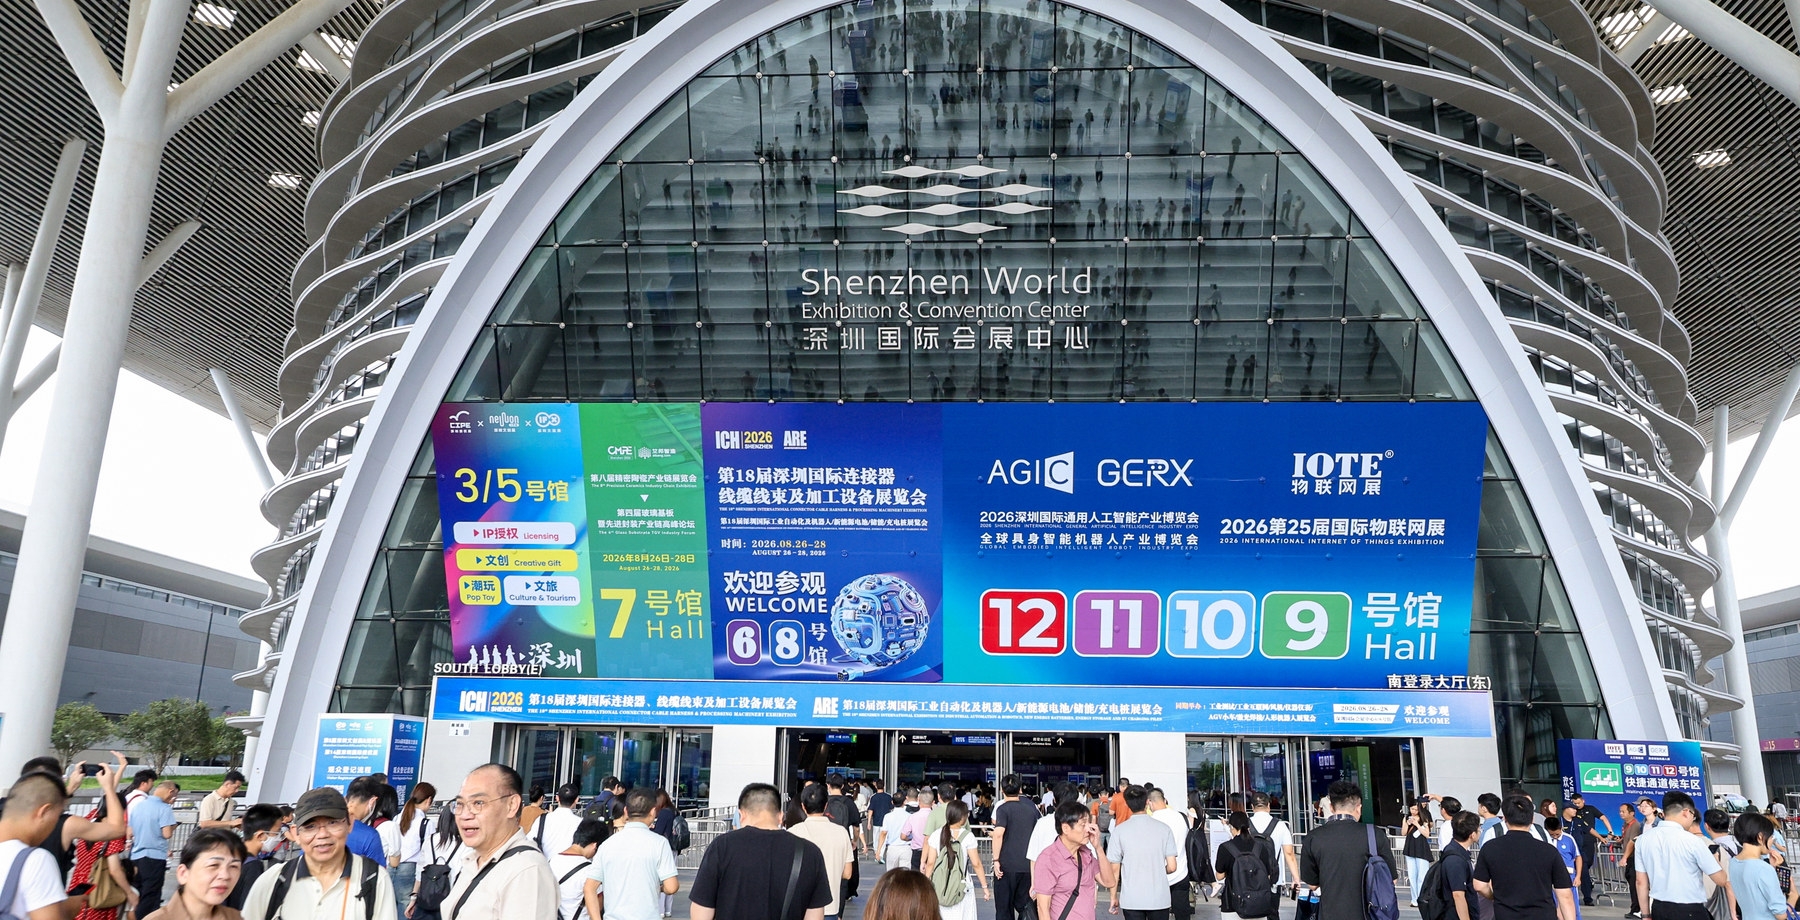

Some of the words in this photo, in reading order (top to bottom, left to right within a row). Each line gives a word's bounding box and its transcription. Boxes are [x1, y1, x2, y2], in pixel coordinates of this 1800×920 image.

[800, 266, 969, 296] Shenzhen
[983, 266, 1091, 295] World
[802, 302, 892, 319] Exhibition
[898, 302, 913, 319] &
[917, 301, 1023, 319] Convention
[1028, 301, 1090, 318] Center
[802, 326, 1090, 350] 深圳国际会展中心
[715, 430, 740, 450] ICH
[743, 431, 773, 444] 2026
[783, 430, 807, 447] ARE
[590, 474, 697, 483] 第八届精密陶瓷产业链展览会
[717, 466, 896, 485] 第18届深圳国际连接器
[986, 456, 1071, 487] AGIC
[1291, 479, 1381, 495] 物联网展
[718, 487, 928, 506] 线缆线束及加工设备展览会
[616, 509, 674, 517] 第四届玻璃基板
[979, 511, 1199, 524] 2026深圳国际通用人工智能产业博览会
[597, 520, 696, 529] 暨先进封装产业链高峰论坛
[1219, 517, 1445, 536] 2026第25届国际物联网展
[483, 528, 519, 540] IP授权
[523, 533, 559, 541] Licensing
[980, 532, 1199, 546] 全球具身智能机器人产业博览会
[485, 555, 509, 566] 文创
[547, 559, 561, 567] Gift
[602, 553, 695, 563] 2026年8月26日-28日
[471, 580, 496, 592] 潮玩
[534, 581, 558, 592] 文旅
[723, 570, 827, 595] 欢迎参观
[466, 594, 481, 602] Pop
[482, 594, 495, 602] Toy
[509, 594, 537, 602] Culture
[538, 594, 545, 602] &
[546, 594, 576, 602] Tourism
[725, 597, 828, 614] WELCOME
[600, 588, 637, 639] 7
[644, 589, 703, 617] 号馆
[988, 598, 1058, 648] 12
[1090, 599, 1142, 649] 11
[1175, 599, 1247, 650] 10
[1285, 600, 1329, 651] 9
[1361, 591, 1442, 630] 号馆
[647, 619, 703, 639] Hall
[732, 626, 757, 659] 6
[775, 627, 800, 660] 8
[1364, 632, 1436, 661] Hall
[528, 642, 582, 675] 深圳
[433, 662, 478, 674] SOUTH
[484, 663, 543, 676] LOBBY(E)
[459, 690, 487, 712] ICH
[491, 691, 524, 706] 2026
[528, 693, 797, 710] 第18届深圳国际连接器、线缆线束及加工设备展览会
[813, 697, 839, 715] ARE
[1404, 705, 1450, 716] 欢迎参观
[1405, 717, 1450, 725] WELCOME
[1678, 766, 1699, 777] 号馆
[1625, 777, 1701, 790] 快捷通道候车区
